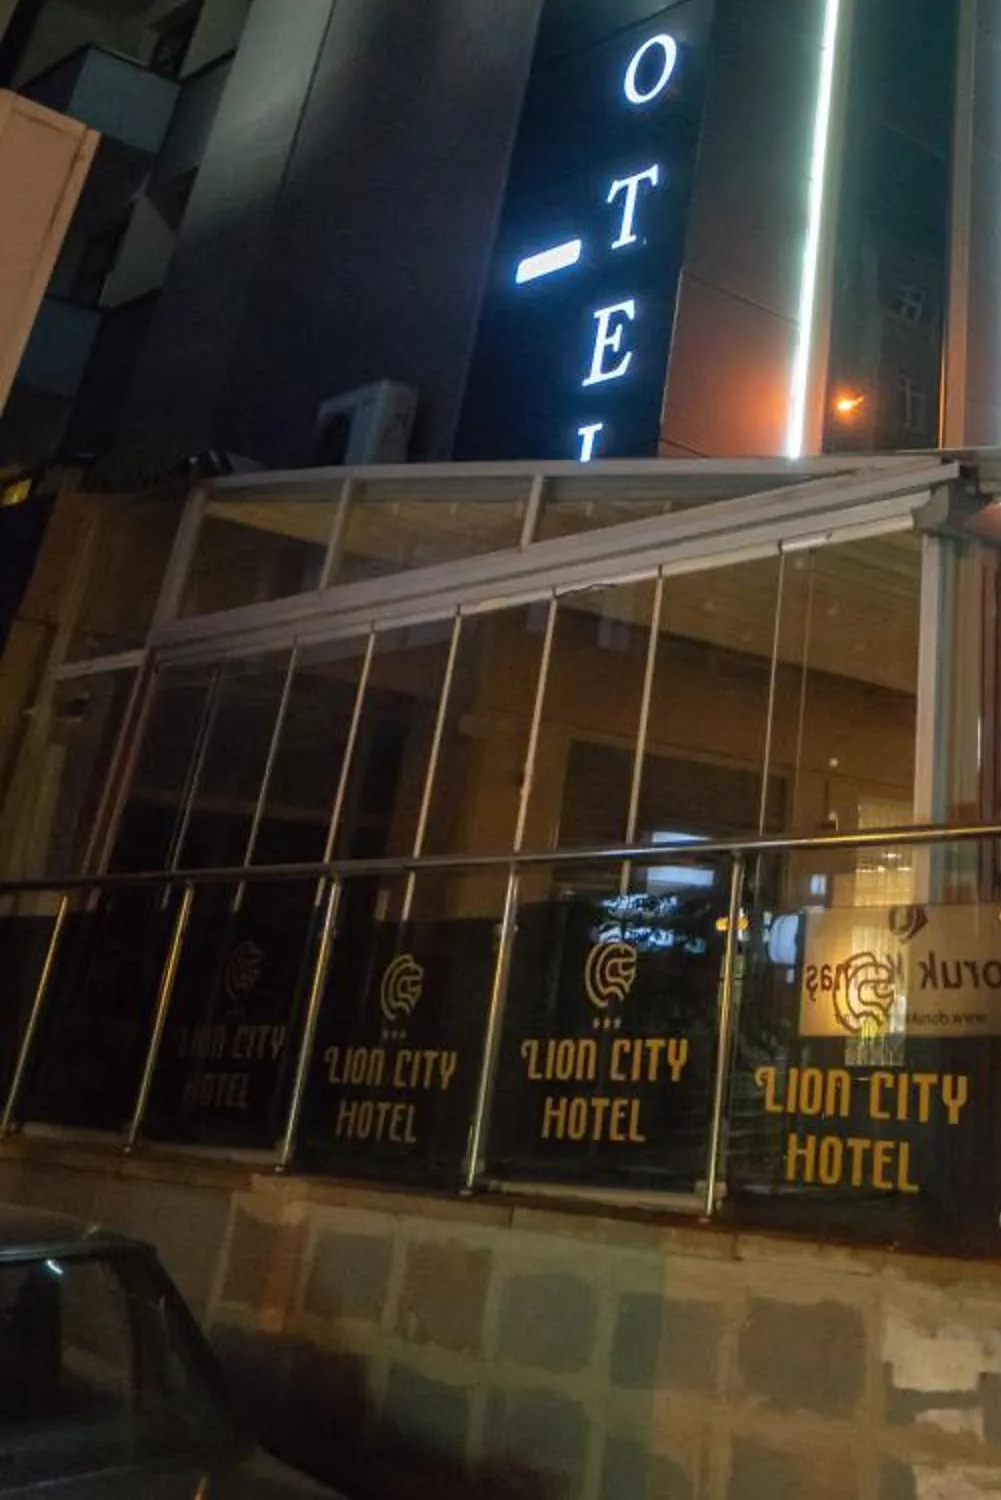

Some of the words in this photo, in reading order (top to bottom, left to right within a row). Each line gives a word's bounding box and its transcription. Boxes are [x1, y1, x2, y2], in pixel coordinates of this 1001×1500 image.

[324, 1047, 385, 1087] LION
[393, 1050, 457, 1090] CITY
[521, 1038, 598, 1081] LION
[609, 1037, 689, 1082] CITY
[754, 1066, 853, 1118] LION
[868, 1067, 969, 1125] CITY
[336, 1102, 417, 1143] HOTEL
[541, 1097, 645, 1143] HOTEL
[785, 1133, 920, 1193] HOTEL
